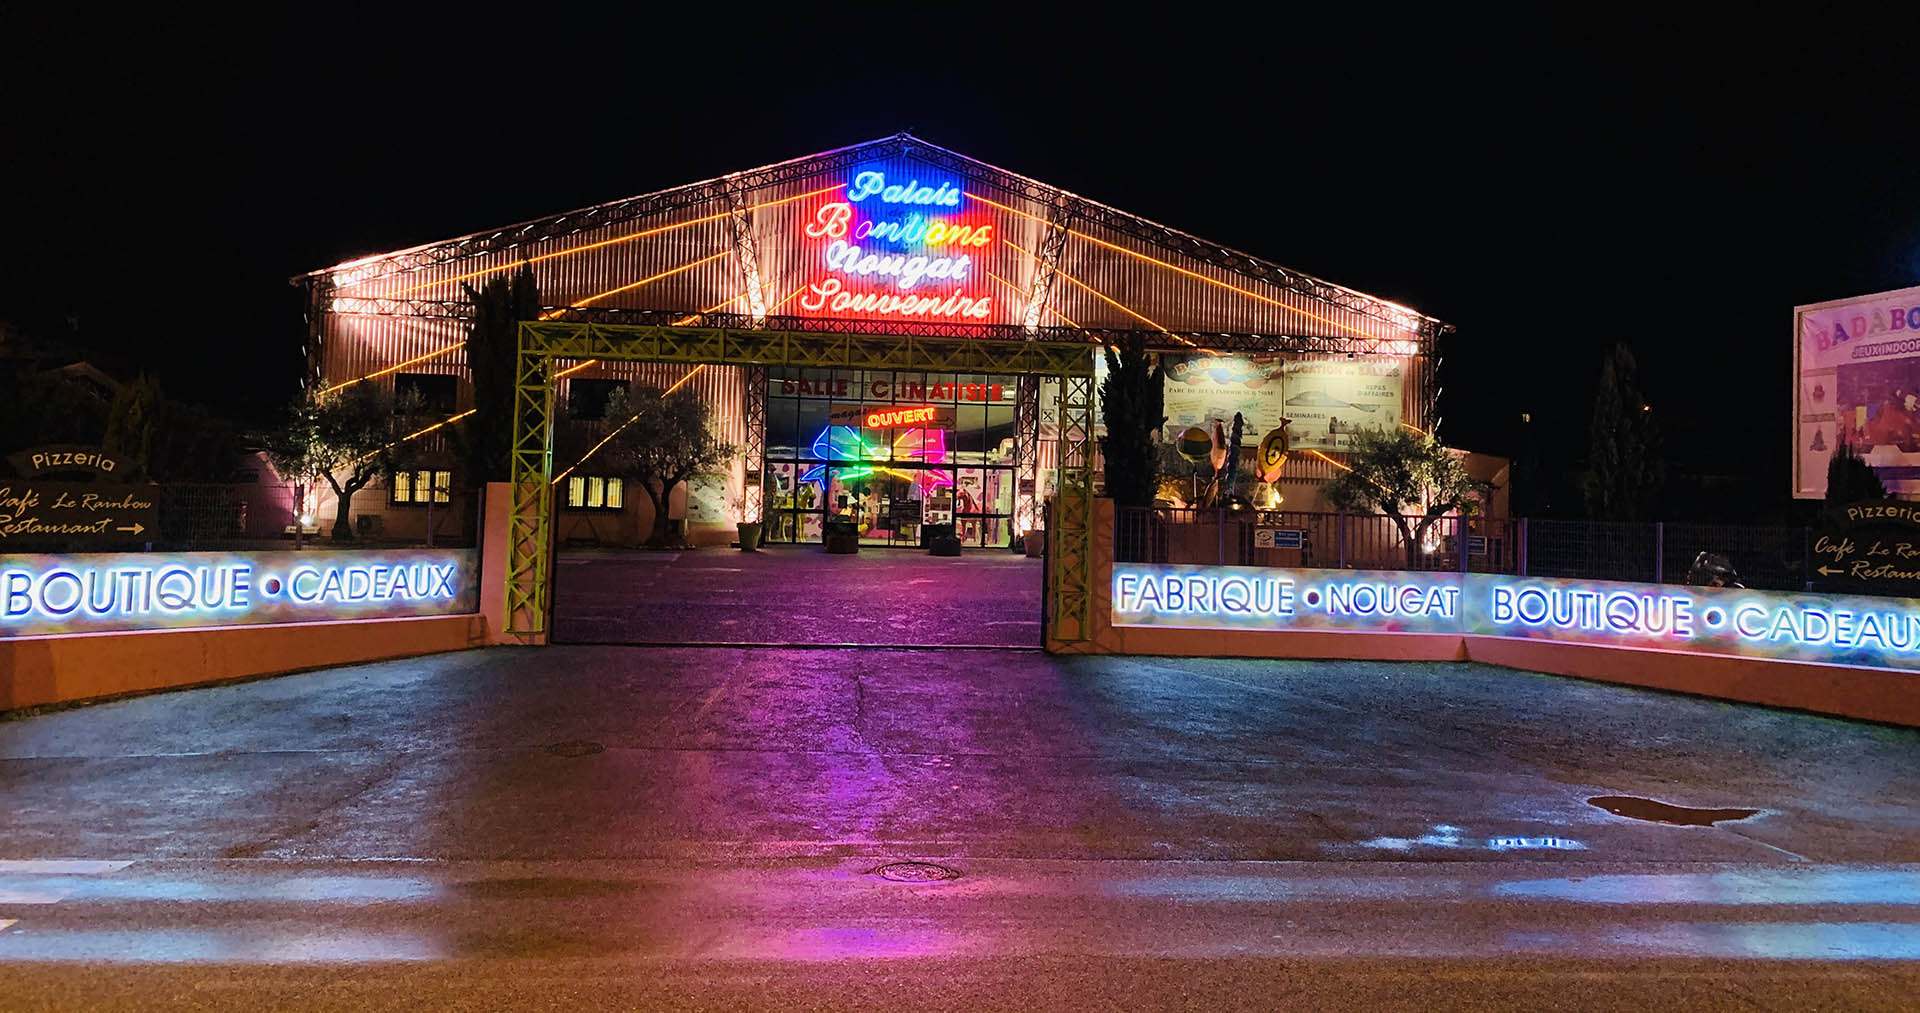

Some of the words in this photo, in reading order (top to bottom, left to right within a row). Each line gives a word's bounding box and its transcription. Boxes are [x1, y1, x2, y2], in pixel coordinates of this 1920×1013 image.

[848, 171, 961, 206] Palais
[826, 240, 971, 289] Nougat
[801, 278, 992, 318] Souvenirs
[1815, 306, 1920, 352] BADABO
[1852, 344, 1880, 358] JEUX
[783, 378, 847, 396] SALLE
[867, 407, 935, 427] OUVERT
[32, 452, 116, 472] Pizzeria
[746, 472, 759, 480] WC
[0, 487, 40, 518] Café
[51, 492, 77, 509] Le
[1815, 536, 1855, 562] Café
[1866, 541, 1890, 555] Le
[4, 568, 250, 617] BOUTIQUE
[293, 566, 455, 601] CADEAUX
[1120, 577, 1293, 614] FABRIQUE
[1330, 586, 1460, 616] NOUGAT
[1494, 588, 1690, 636] BOUTIQUE
[1736, 607, 1920, 649] CADEAU
